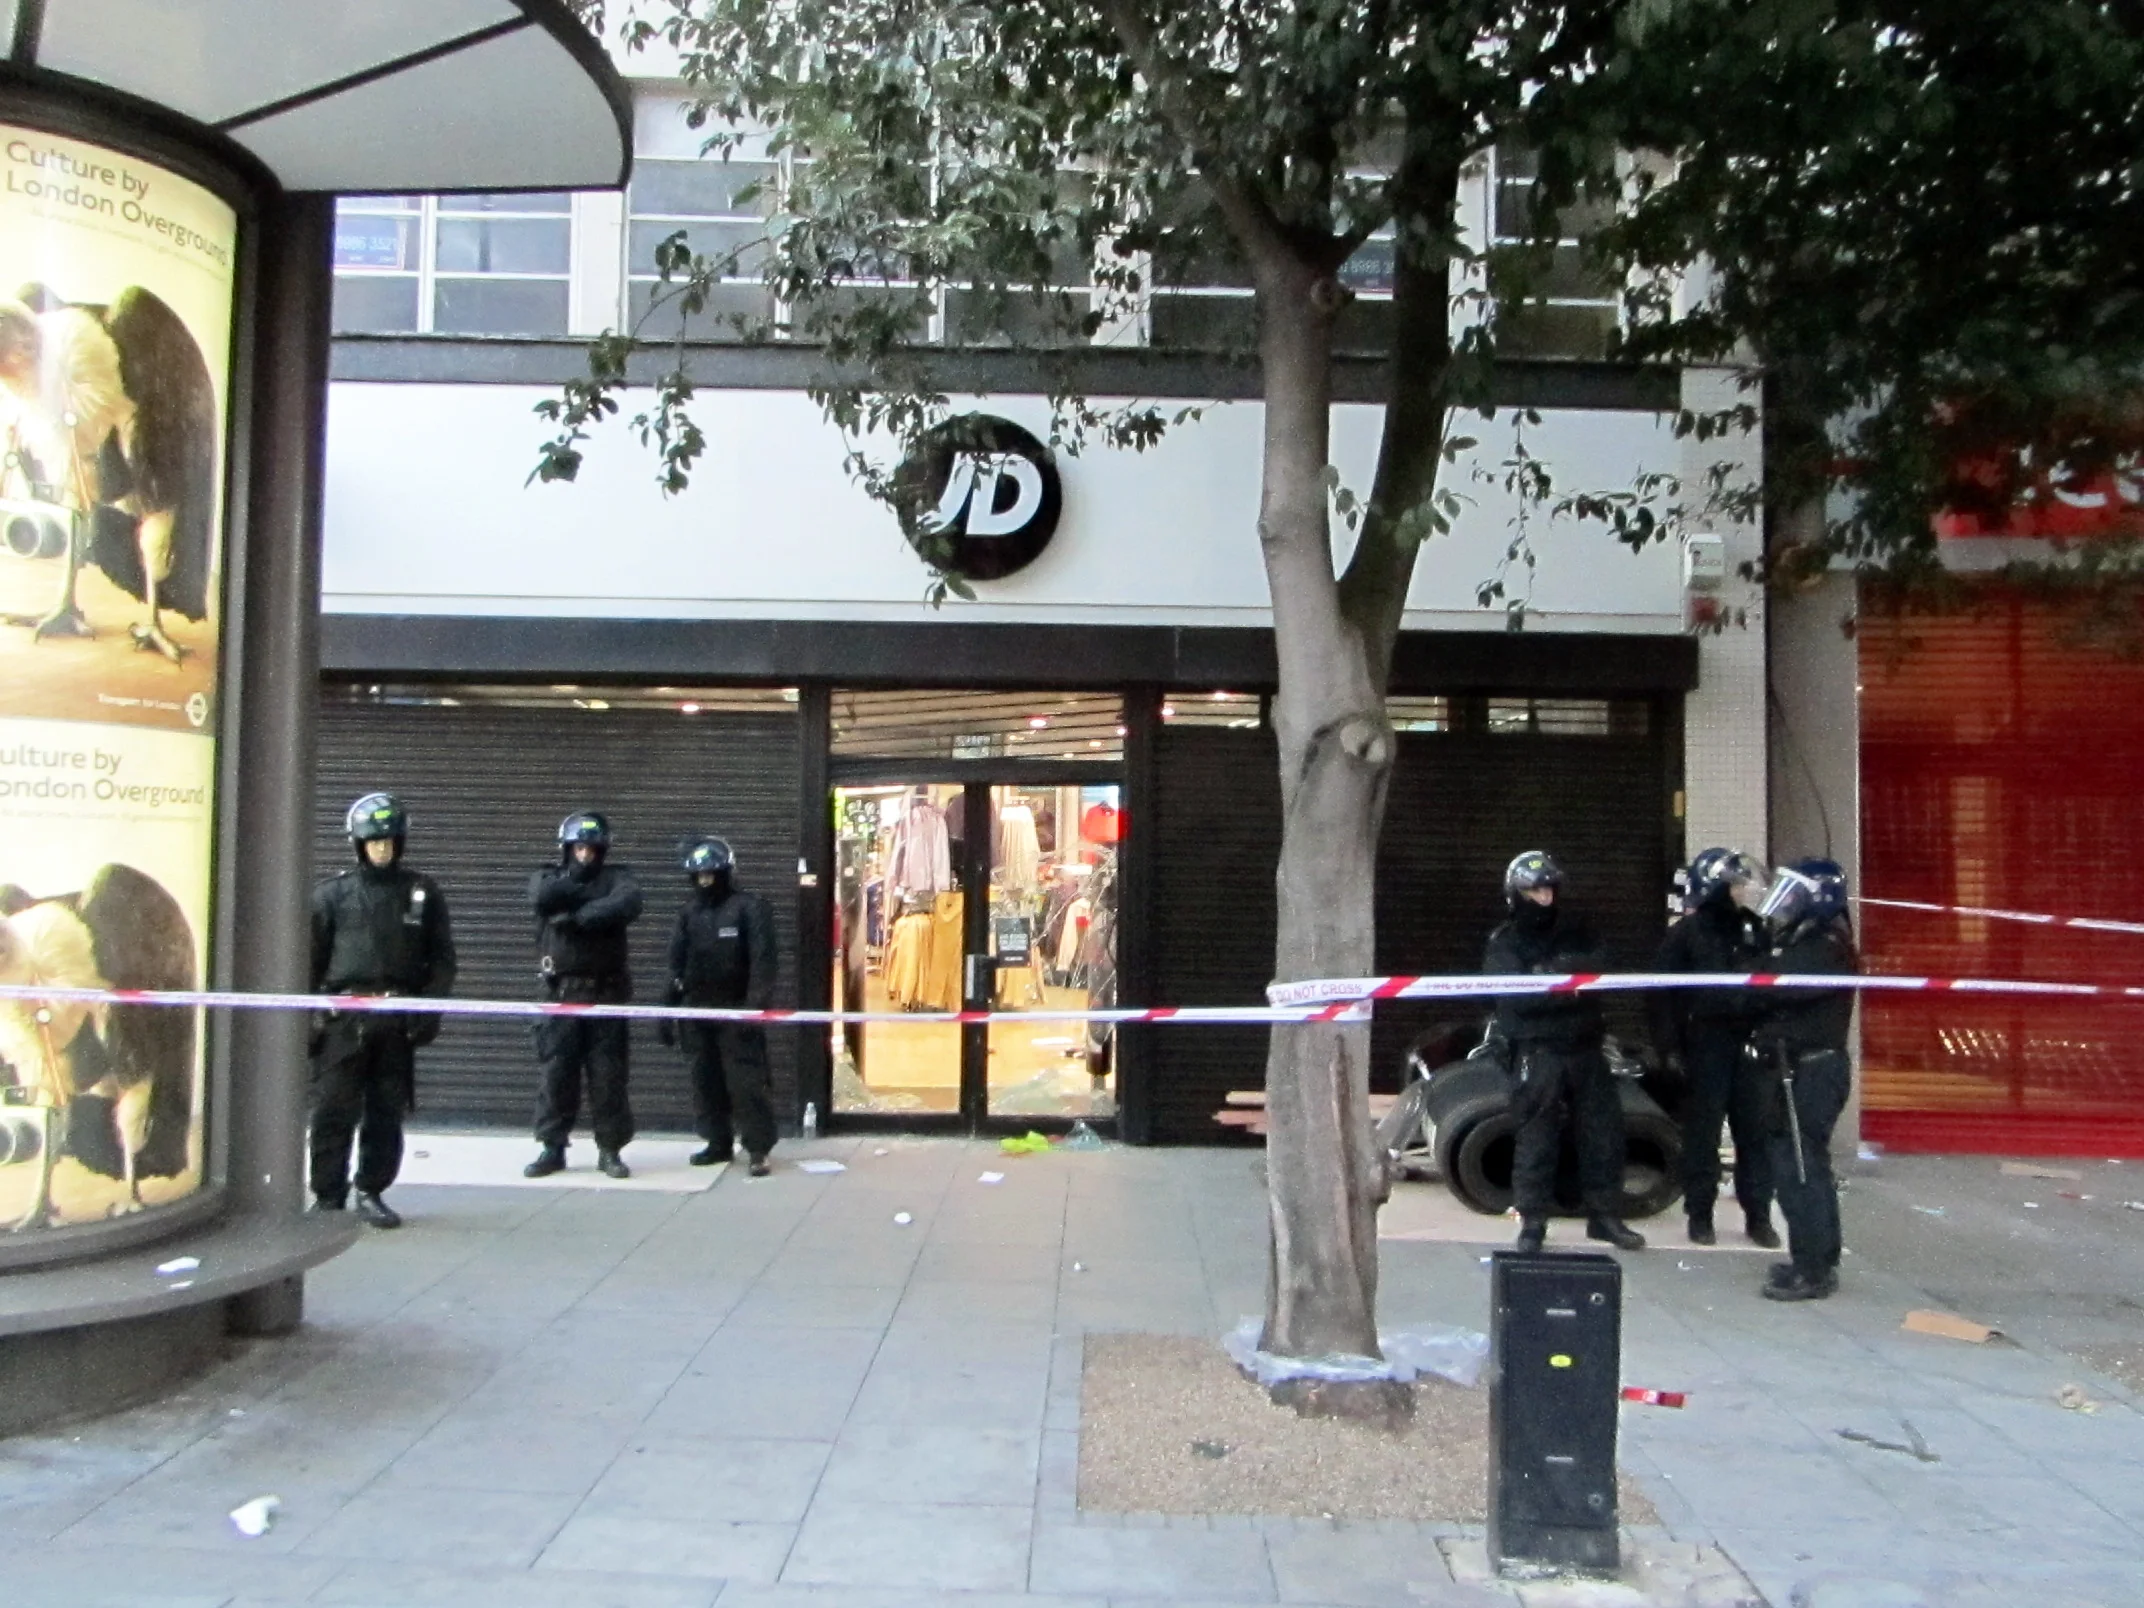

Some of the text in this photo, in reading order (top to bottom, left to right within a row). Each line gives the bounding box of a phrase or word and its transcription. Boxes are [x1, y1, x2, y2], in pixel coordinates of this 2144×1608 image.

[5, 140, 150, 200] Culture by
[6, 170, 116, 217] London
[916, 450, 1043, 535] JD
[0, 744, 122, 775] ulture by
[0, 775, 205, 807] ondon Overground
[1293, 985, 1316, 1000] NOT
